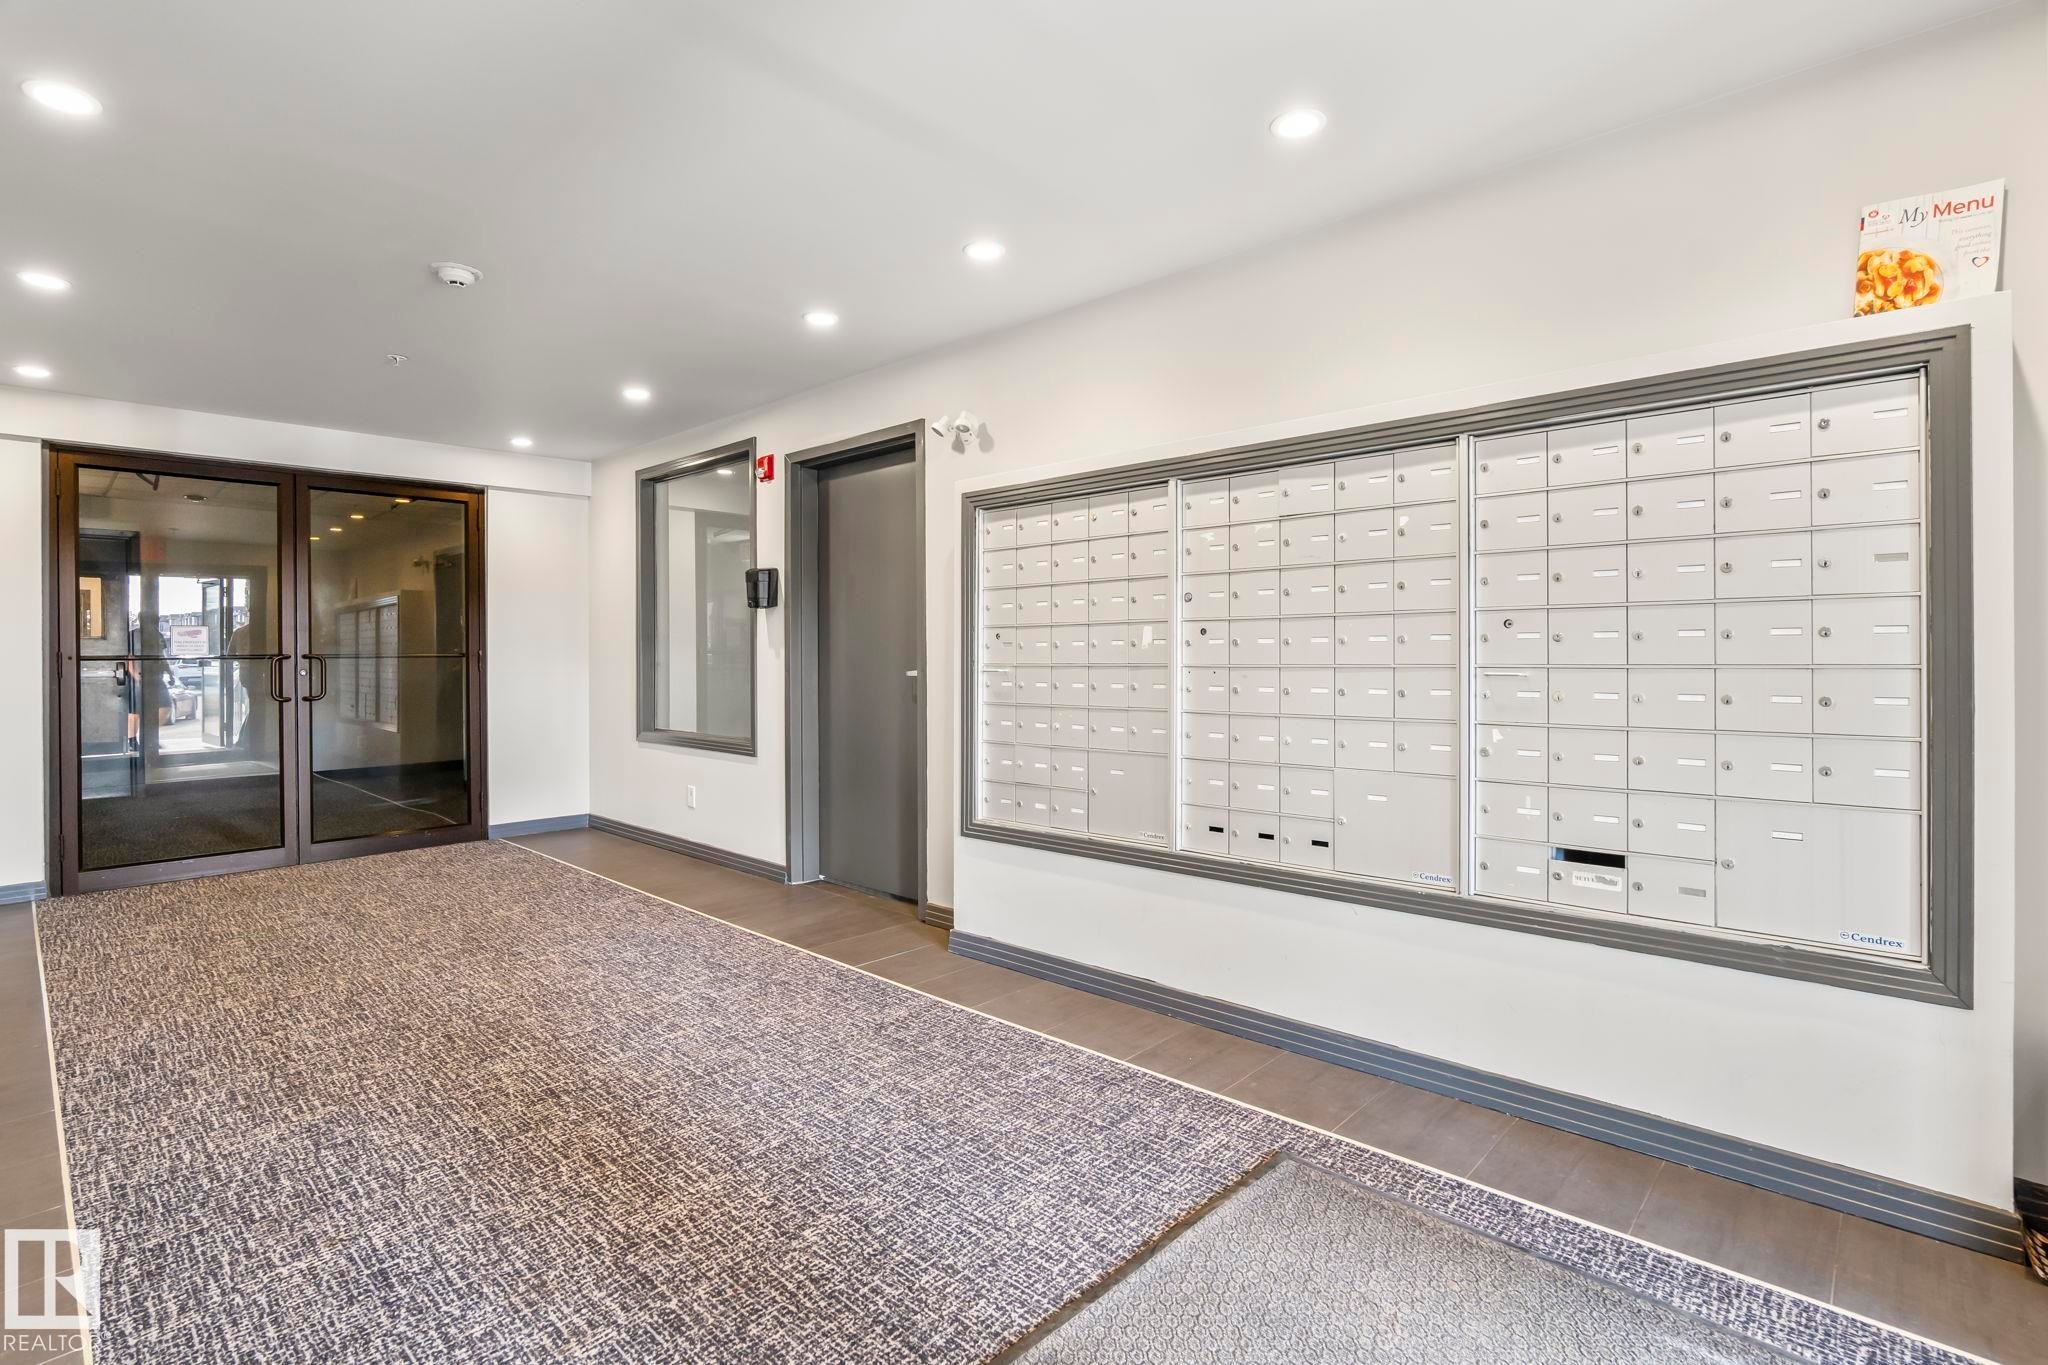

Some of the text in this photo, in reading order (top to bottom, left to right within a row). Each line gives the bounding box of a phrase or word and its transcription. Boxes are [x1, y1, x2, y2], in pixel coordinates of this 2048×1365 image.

[1899, 206, 1928, 228] My
[1932, 195, 1994, 218] Menu
[1419, 872, 1452, 883] Cendrex
[1851, 933, 1903, 948] Cendrex
